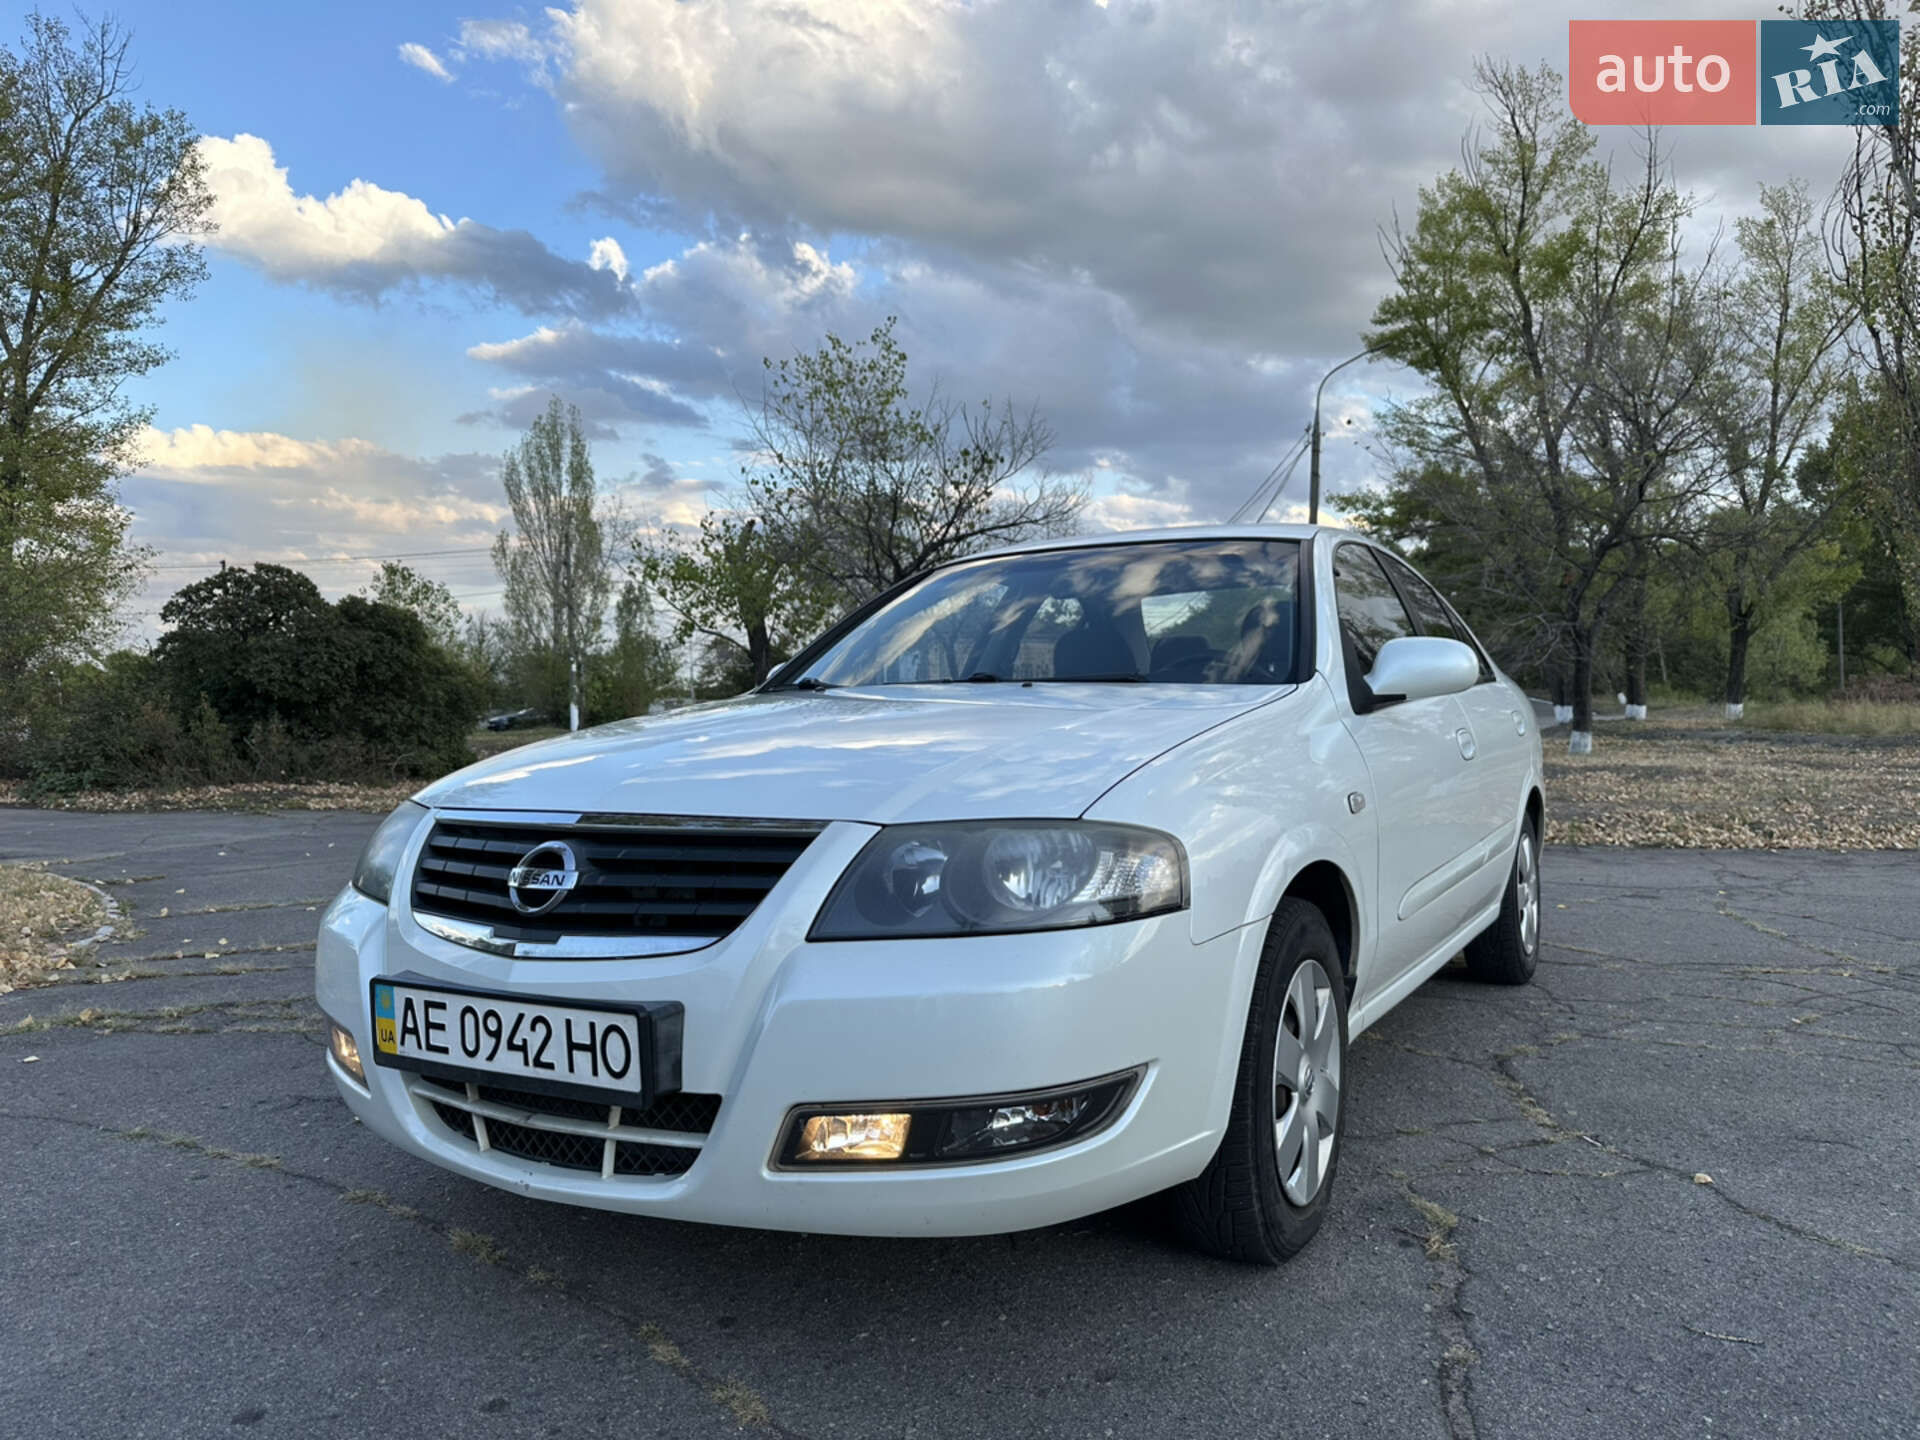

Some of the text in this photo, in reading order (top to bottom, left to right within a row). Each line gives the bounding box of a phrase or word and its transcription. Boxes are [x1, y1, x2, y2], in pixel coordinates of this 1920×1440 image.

[512, 871, 565, 887] NSSAN
[380, 1029, 396, 1043] UA
[400, 997, 631, 1080] AE 0942 HO
